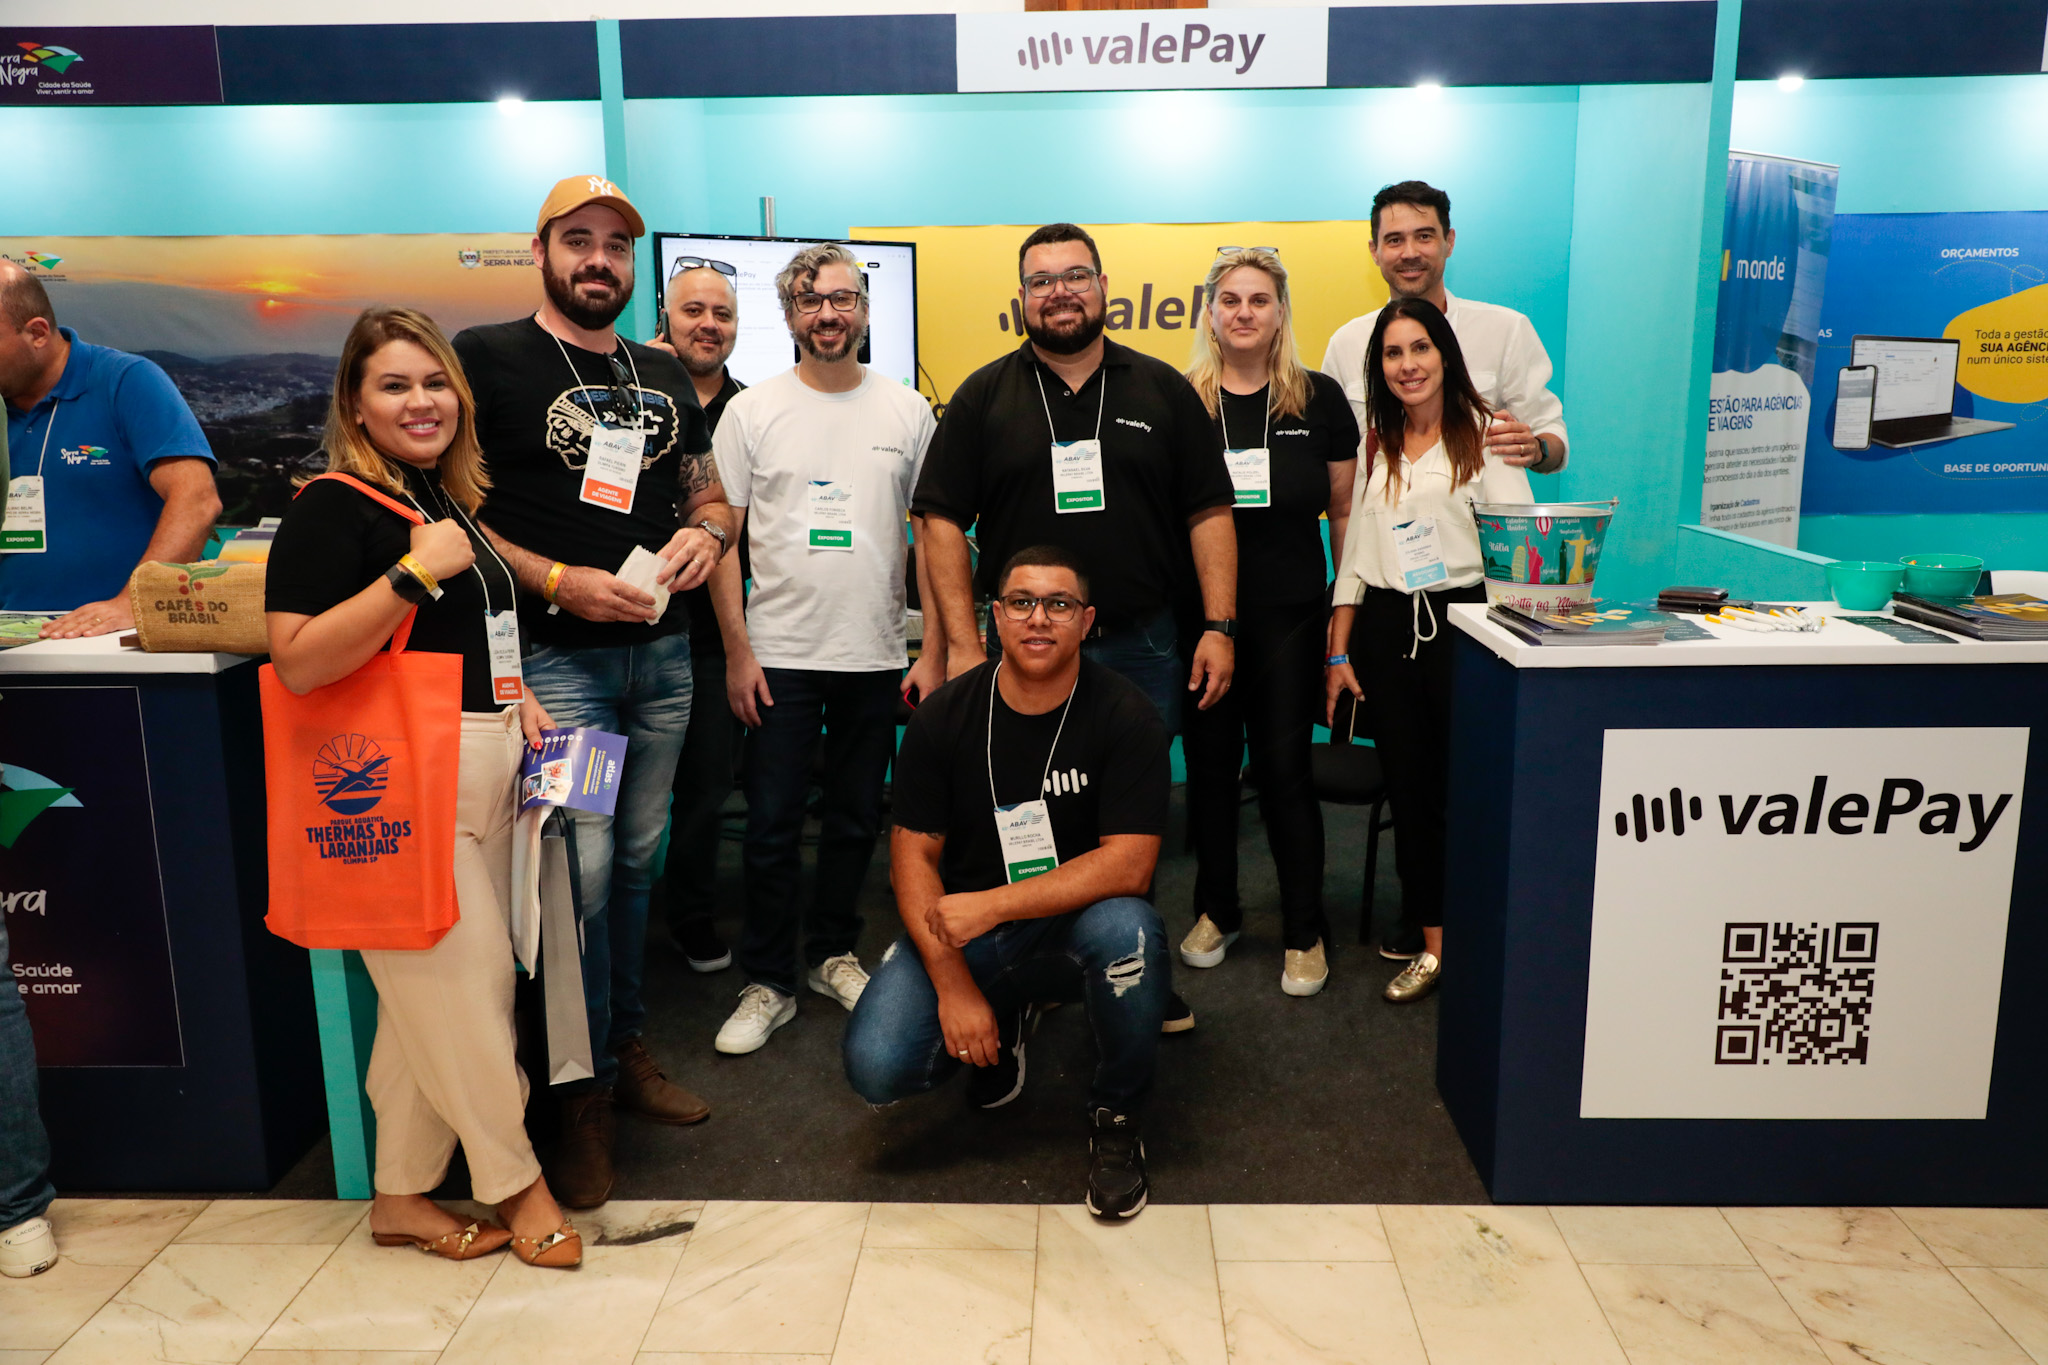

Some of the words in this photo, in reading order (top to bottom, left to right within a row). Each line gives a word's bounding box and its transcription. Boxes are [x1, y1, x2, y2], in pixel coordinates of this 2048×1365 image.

[1082, 22, 1266, 75] valePay
[0, 54, 20, 64] rra
[1941, 248, 2019, 259] ORÇAMENTOS
[1736, 255, 1785, 281] monde
[1818, 328, 1833, 338] AS
[1976, 329, 2001, 339] Toda
[1980, 343, 2003, 352] SUA
[2007, 341, 2048, 352] AGÊNCI
[1994, 354, 2023, 364] único
[2026, 354, 2048, 363] siste
[1709, 395, 1740, 414] ESTÃO
[1741, 397, 1762, 412] PARA
[1126, 420, 1152, 432] valePay
[1708, 417, 1715, 431] E
[603, 441, 622, 450] ABAV
[881, 446, 904, 456] valePay
[61, 448, 79, 459] Serra
[67, 455, 88, 465] Negra
[1944, 464, 1973, 472] BASE
[1975, 464, 1990, 472] DE
[1993, 463, 2048, 472] OPORTUNI
[597, 487, 619, 496] AGENTE
[600, 493, 622, 504] VIAGENS
[1406, 534, 1420, 542] ABAV
[155, 598, 205, 612] CAFÉS
[208, 601, 228, 612] DO
[168, 613, 220, 625] BRASIL
[604, 759, 617, 784] atlas
[1718, 775, 2013, 853] valePay
[305, 824, 376, 843] THERMAS
[381, 820, 412, 838] DOS
[320, 838, 399, 859] LARANJAIS
[1018, 865, 1047, 874] EXPOSITOR
[12, 962, 73, 978] Saúde
[18, 984, 28, 994] e
[32, 982, 82, 995] amar
